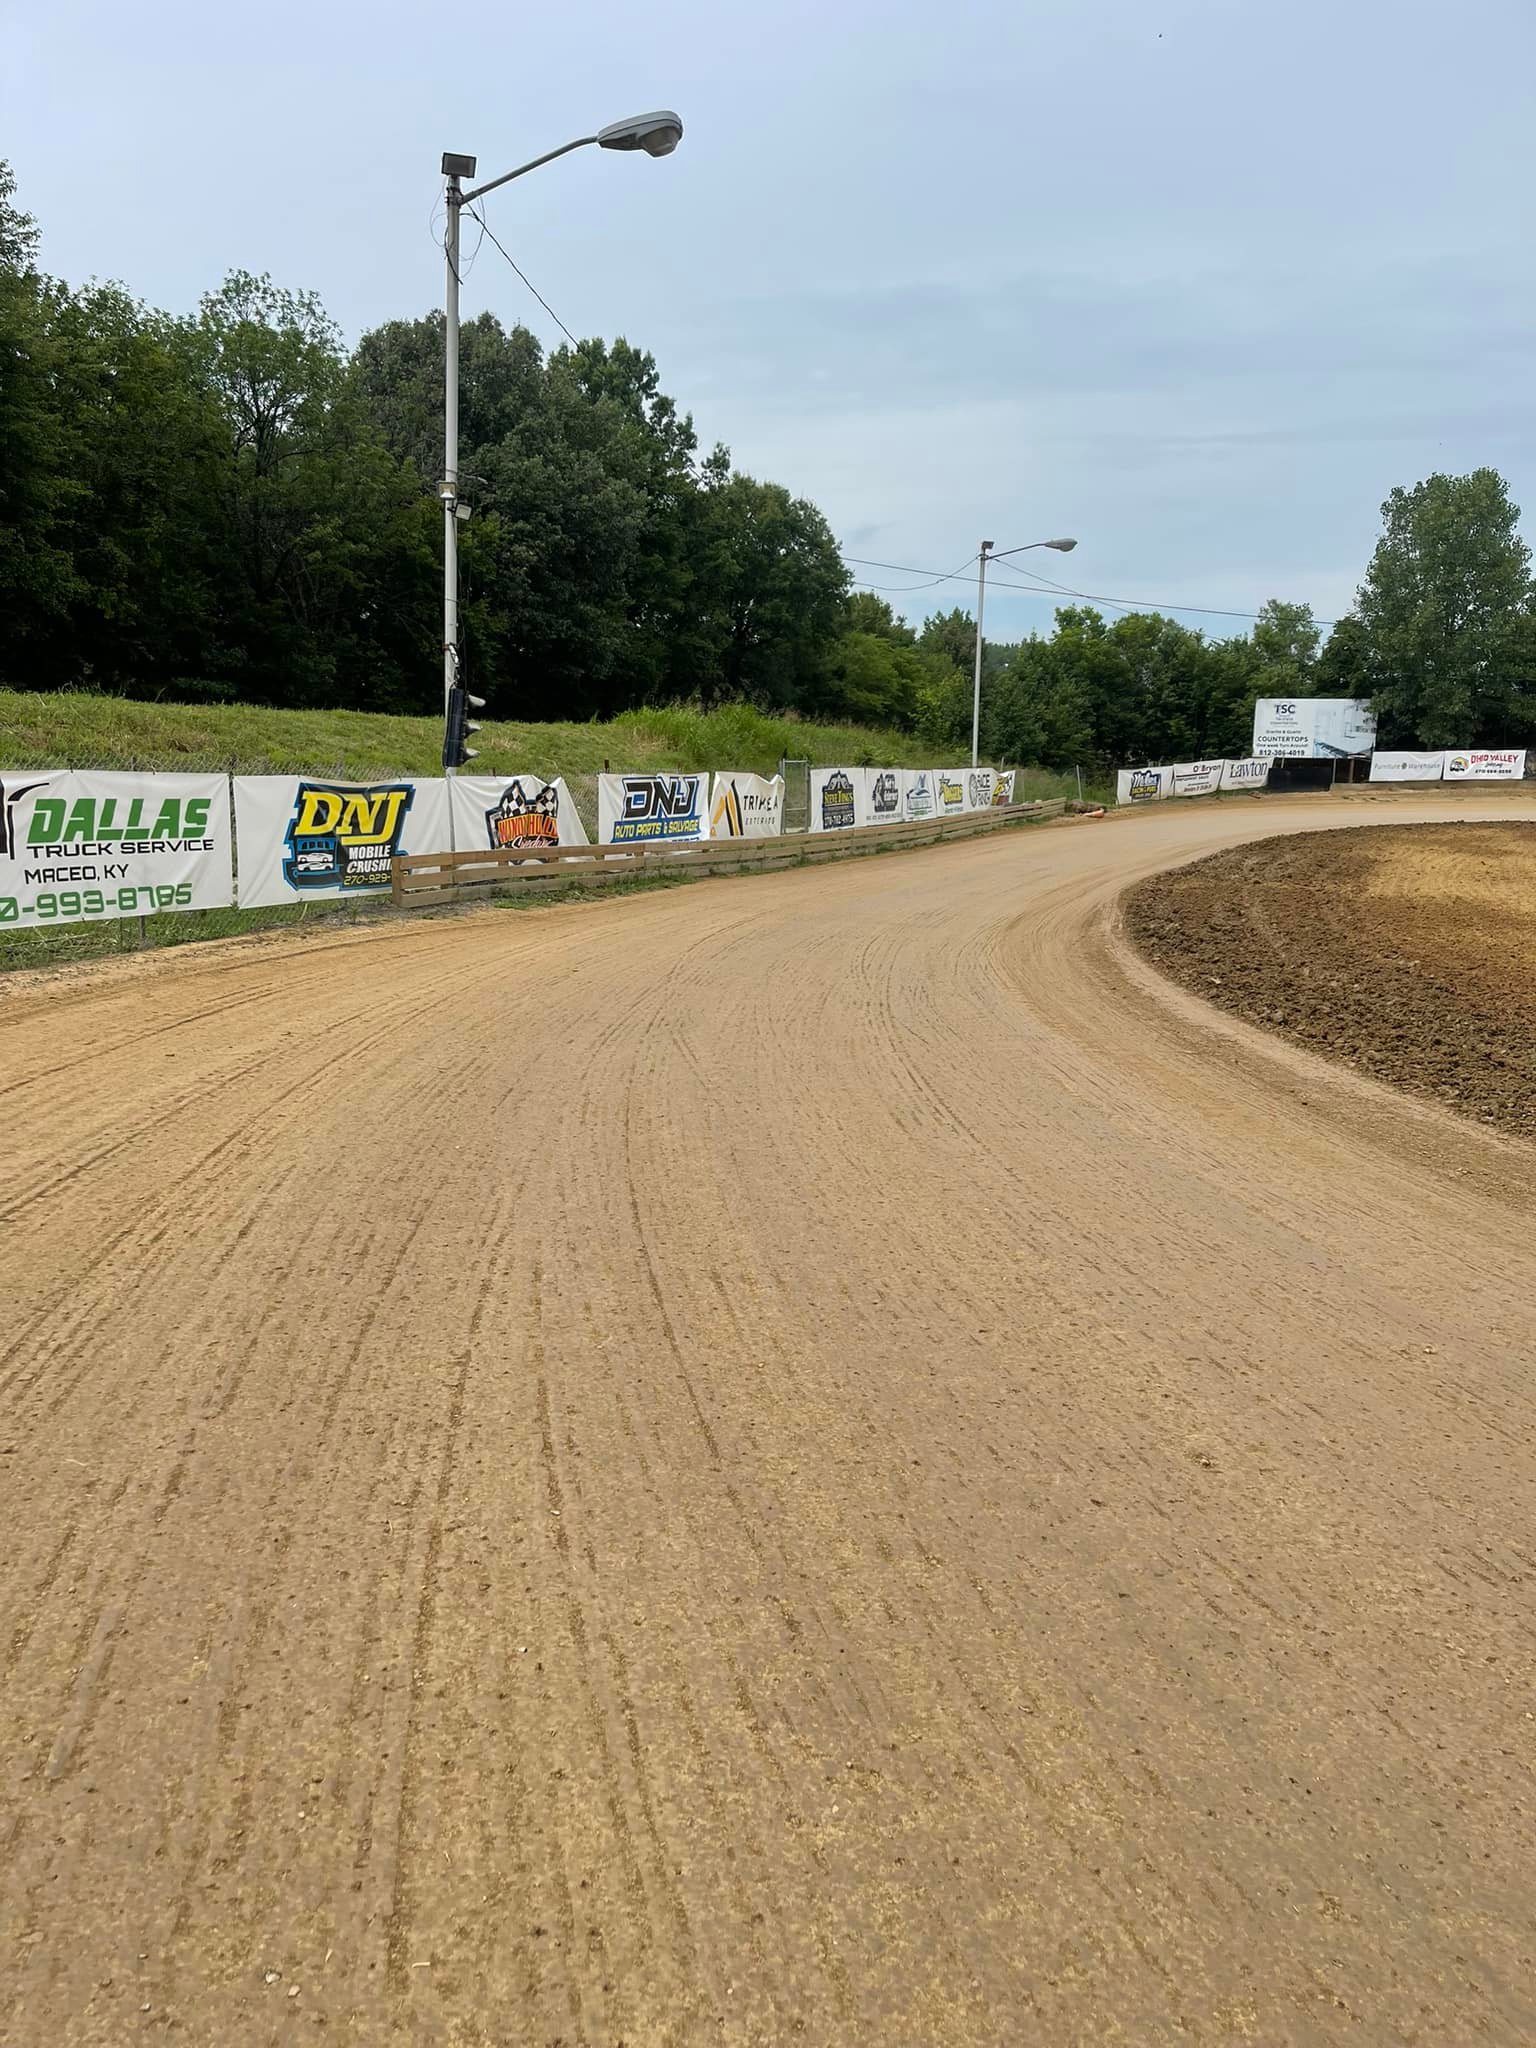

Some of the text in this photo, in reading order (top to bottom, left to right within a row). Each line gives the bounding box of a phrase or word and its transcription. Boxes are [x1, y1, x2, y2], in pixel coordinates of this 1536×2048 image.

[1274, 704, 1296, 714] TSC
[1470, 754, 1519, 764] OHIO VALLEY
[1229, 760, 1268, 778] Lawton
[624, 779, 696, 819] DNJ
[26, 797, 212, 844] DALLAS
[294, 791, 407, 846] DNJ
[498, 815, 528, 844] WINDY
[614, 823, 635, 839] AUTO
[636, 821, 662, 837] PARTS
[668, 820, 699, 834] SALVAGE
[26, 839, 215, 859] TRUCK SERVICE
[348, 844, 391, 861] MOBILE
[24, 863, 129, 885] MACEO, KY
[346, 859, 393, 874] CRUSHI
